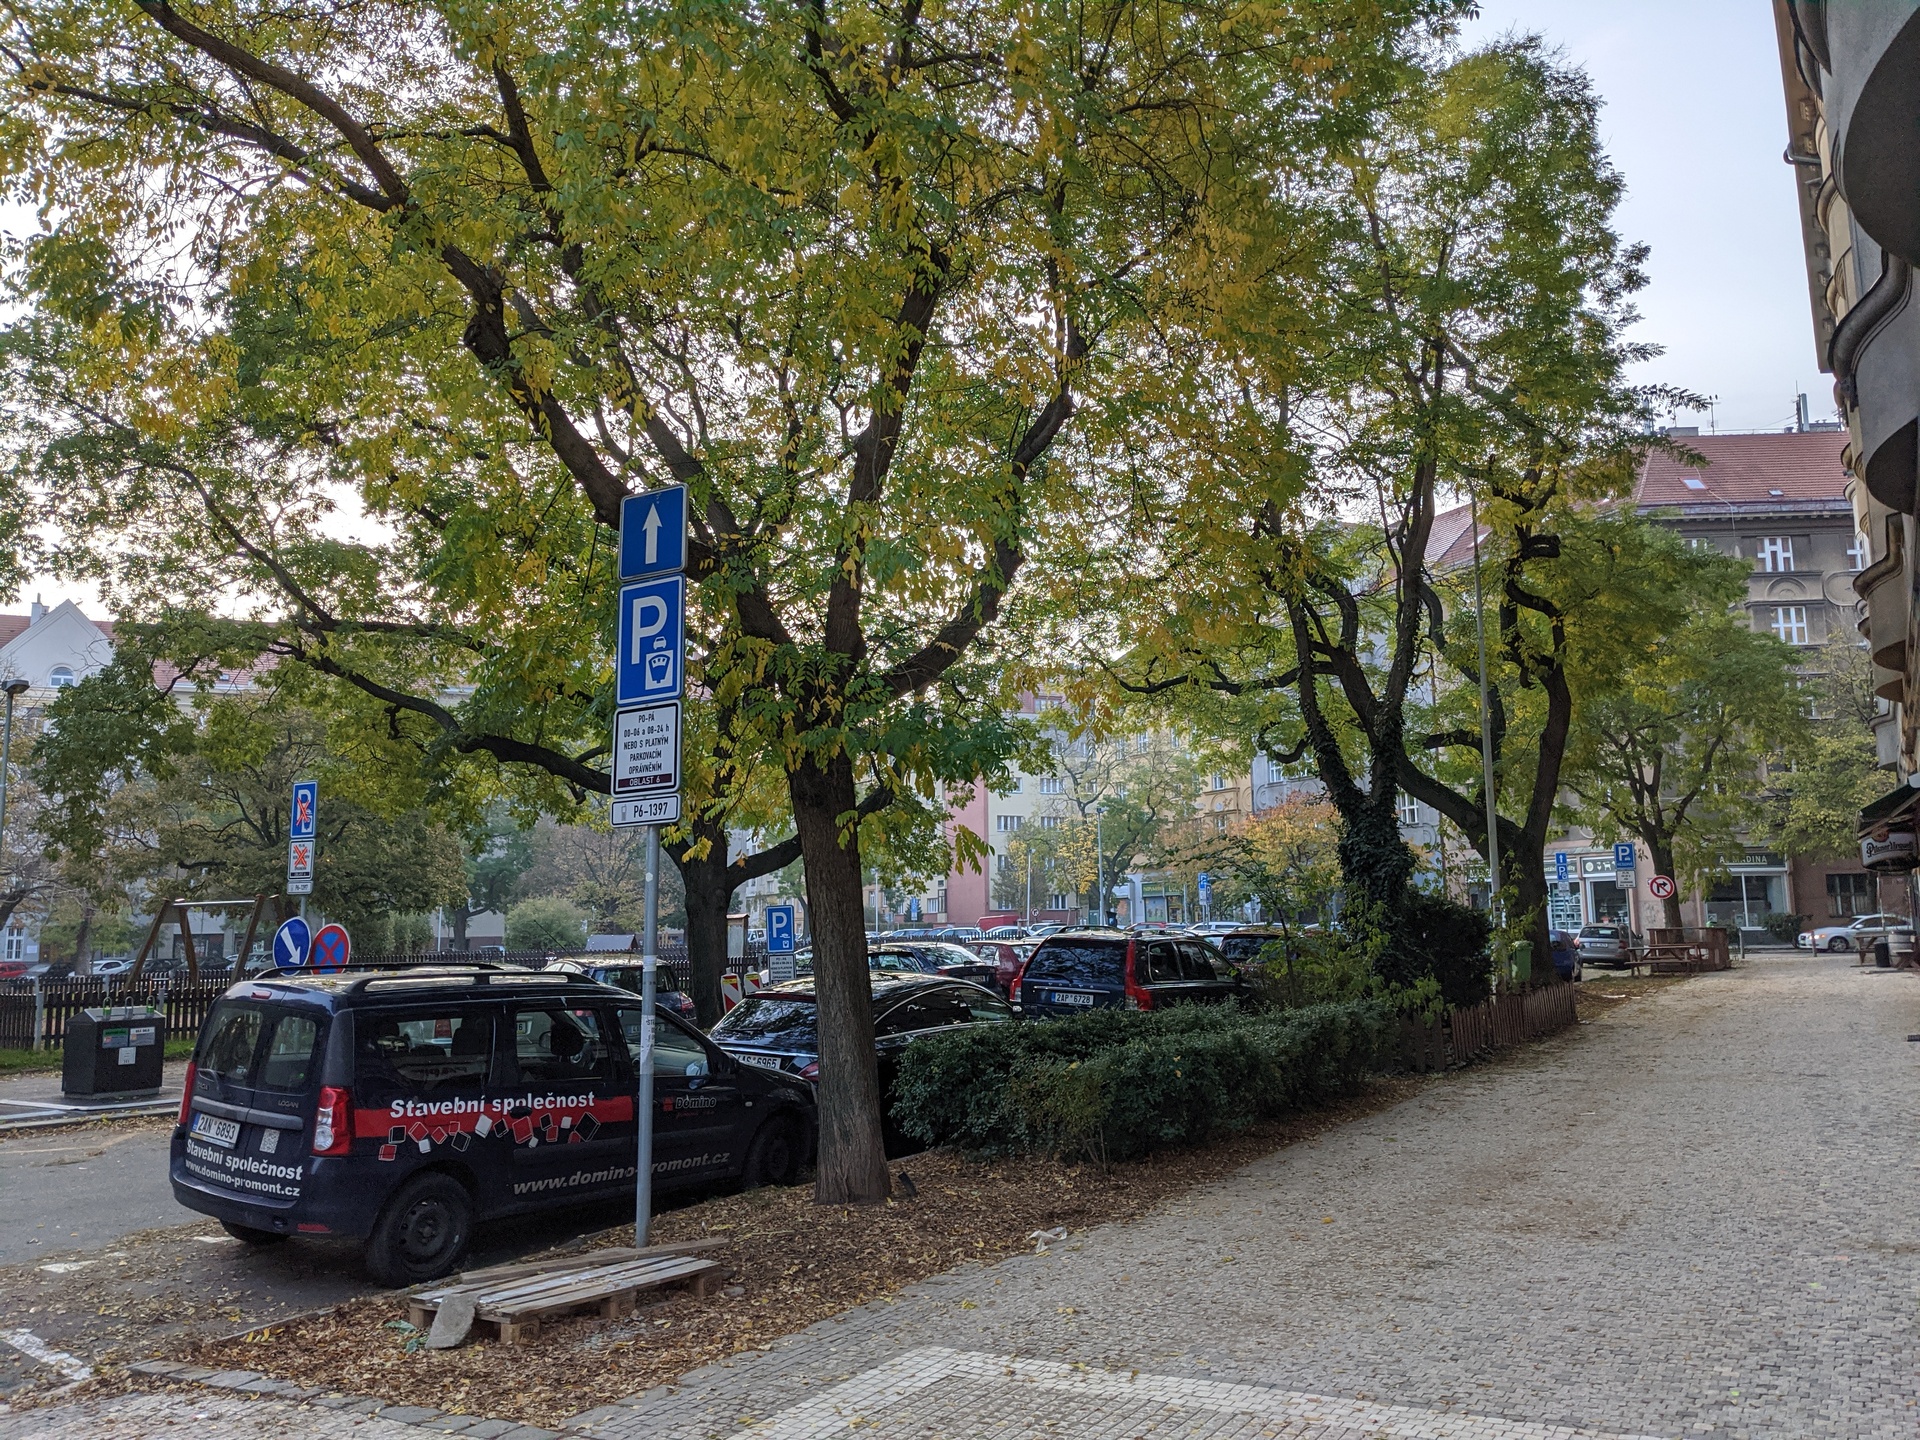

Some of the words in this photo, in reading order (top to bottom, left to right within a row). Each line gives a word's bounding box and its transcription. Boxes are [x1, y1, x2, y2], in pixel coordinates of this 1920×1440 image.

[631, 595, 668, 665] P
[638, 711, 655, 723] PO-PÁ
[624, 728, 640, 738] 00-06
[647, 724, 664, 735] 08-24
[624, 740, 638, 750] NEBO
[645, 734, 669, 748] PLATNÝM
[630, 748, 662, 762] PARKOVACÍM
[628, 760, 663, 775] OPRÁVNĚNÍM
[629, 776, 654, 787] OBLAST
[633, 802, 668, 818] P6-1397
[1618, 846, 1630, 861] P
[1559, 866, 1565, 876] P
[772, 912, 788, 938] P
[1056, 994, 1069, 1002] 2AP
[1074, 995, 1091, 1004] 6728
[278, 1100, 299, 1108] LOGAN
[390, 1095, 485, 1118] Stavební
[492, 1091, 595, 1116] společnost
[675, 1095, 717, 1109] Domino
[198, 1116, 213, 1133] 2AN
[216, 1122, 236, 1140] 6893
[225, 1155, 303, 1181] společnost
[514, 1150, 731, 1195] www.domino-romont.cz
[185, 1159, 301, 1196] www.domino-promont.cz
